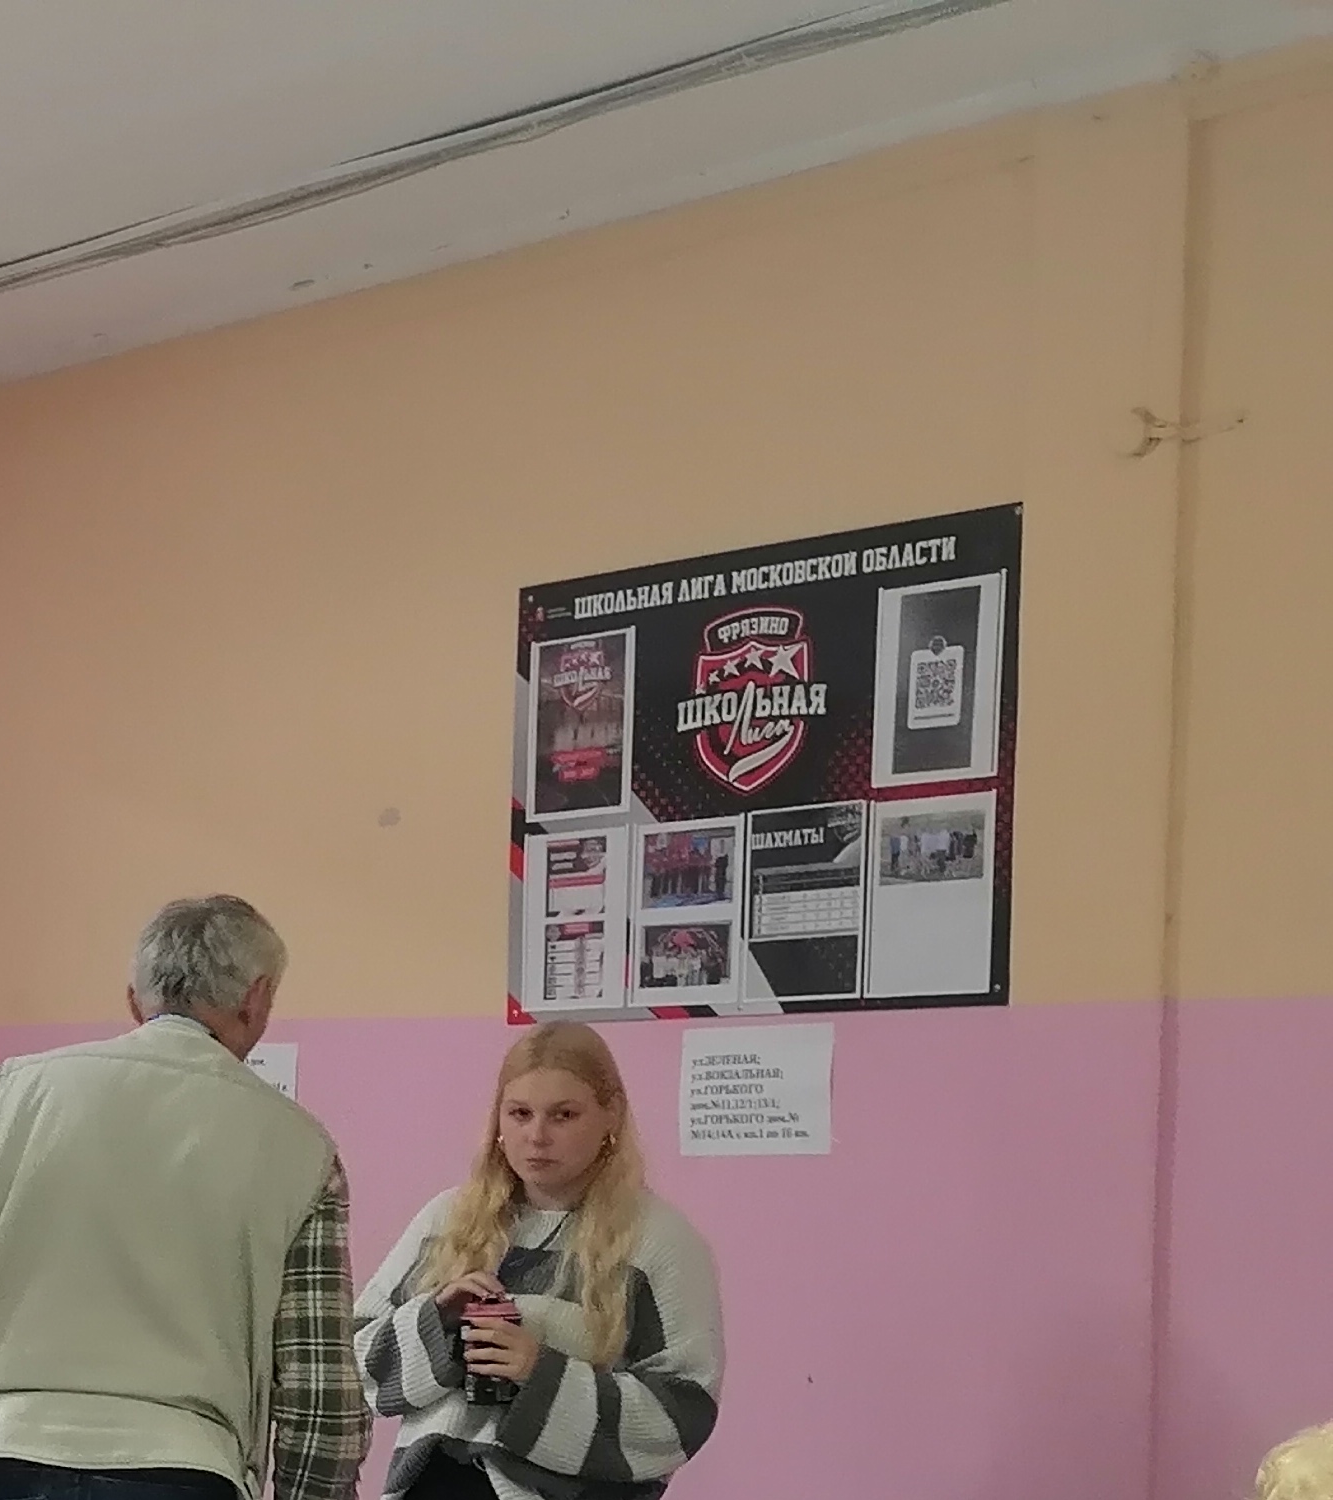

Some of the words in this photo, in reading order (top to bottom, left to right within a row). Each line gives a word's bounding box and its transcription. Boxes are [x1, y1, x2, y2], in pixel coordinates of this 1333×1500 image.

[574, 581, 674, 620] ШКОЛЬНАЯ
[677, 574, 727, 602] ЛИГА
[731, 550, 858, 594] МОСКОВСКОЙ
[862, 536, 957, 573] ОБЛАСТИ
[717, 616, 790, 643] ФРЯЗИНО
[677, 682, 828, 733] ШКОЛЬНАЯ
[751, 827, 825, 850] ШАХМАТЫ
